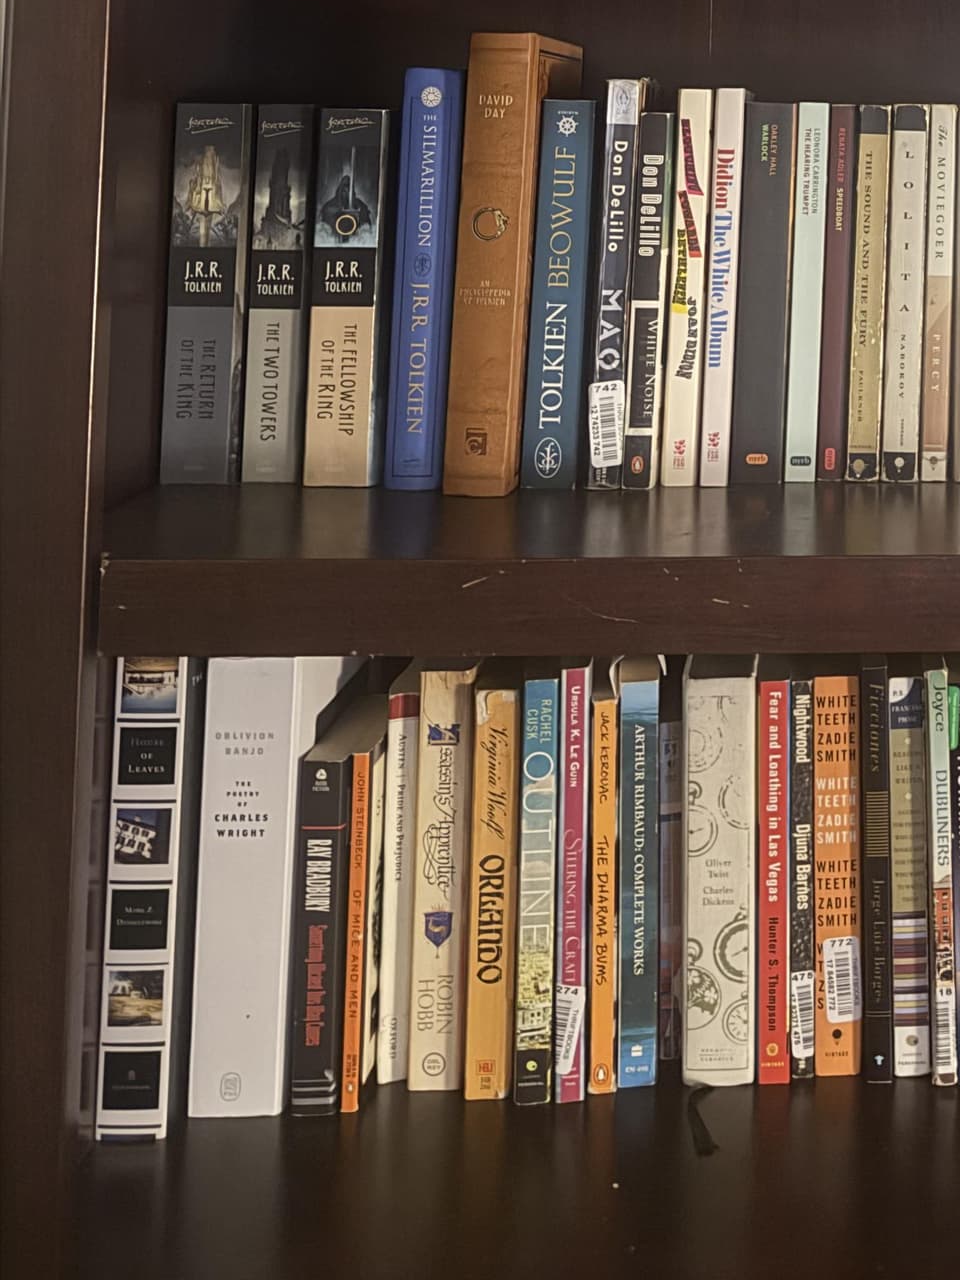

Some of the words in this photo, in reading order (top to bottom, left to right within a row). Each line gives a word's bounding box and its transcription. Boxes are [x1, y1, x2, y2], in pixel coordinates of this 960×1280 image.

[479, 95, 513, 106] DAVID
[484, 108, 506, 119] DAY
[761, 124, 769, 161] WARLOCK
[938, 125, 948, 148] The
[612, 141, 629, 176] Don
[641, 155, 664, 187] Don
[418, 125, 437, 247] SILMARILLION
[715, 149, 735, 208] Didion
[548, 146, 577, 288] BEOWULF
[608, 185, 626, 252] DeLillo
[835, 188, 844, 231] SPEEDBOAT
[935, 157, 947, 259] MOVIEGOER
[638, 194, 662, 257] DeLillo
[258, 264, 295, 281] J.R.R.
[325, 261, 363, 280] J.R.R.
[185, 281, 222, 293] TOLKIEN
[257, 284, 294, 295] TOLKIEN
[325, 281, 362, 293] TOLKIEN
[343, 324, 357, 344] THE
[599, 289, 624, 370] MAO
[645, 320, 658, 370] WHITE
[538, 302, 568, 429] TOLKIEN
[898, 334, 907, 399] NABOKOV
[931, 334, 942, 392] PERCY
[338, 350, 357, 436] FELLOWSHIP
[594, 384, 618, 392] 742
[643, 375, 656, 417] NOISE
[816, 696, 857, 708] WHITE
[931, 685, 946, 732] Joyce
[527, 709, 538, 740] CUSK
[540, 699, 553, 744] RACHEL
[600, 712, 609, 742] JACK
[793, 694, 811, 763] Nightwood
[817, 714, 856, 725] TEETH
[215, 732, 275, 740] OBLIVION
[817, 733, 856, 745] ZADIE
[225, 747, 264, 756] BANJO
[816, 750, 857, 761] SMITH
[128, 765, 165, 773] LEAVES
[599, 745, 609, 804] KEROUAC
[816, 777, 857, 790] WHITE
[817, 796, 857, 807] TEETH
[214, 814, 269, 822] CHARLES
[217, 829, 265, 837] WRIGHT
[817, 814, 856, 826] ZADIE
[936, 770, 950, 866] DUBLINERS
[306, 839, 332, 859] RAY
[793, 823, 810, 861] Djuna
[816, 832, 857, 844] SMITH
[816, 860, 857, 872] WHITE
[305, 862, 331, 912] BRADBURY
[796, 865, 811, 910] Barnes
[817, 878, 857, 890] TEETH
[817, 896, 857, 909] ZADIE
[476, 854, 505, 984] ORLANDO
[816, 914, 857, 926] SMITH
[830, 939, 853, 947] 772
[417, 979, 435, 1032] HOBB
[437, 974, 454, 1034] ROBIN
